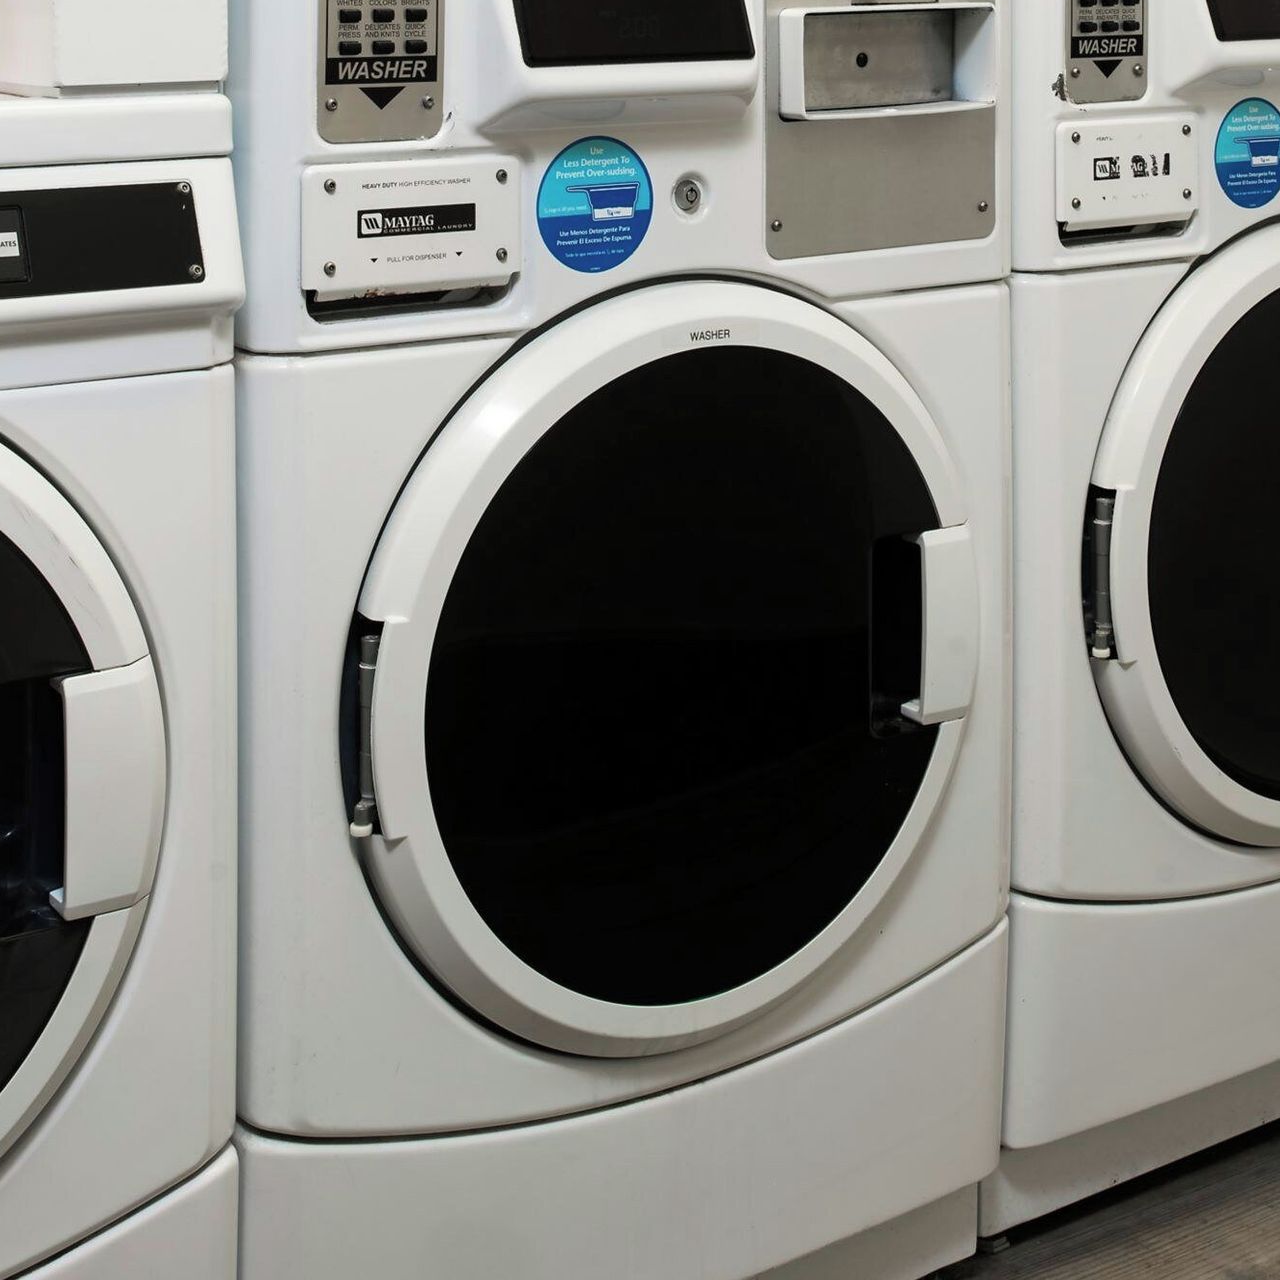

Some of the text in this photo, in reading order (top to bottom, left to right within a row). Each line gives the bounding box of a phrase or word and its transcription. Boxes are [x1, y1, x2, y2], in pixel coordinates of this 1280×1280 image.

[336, 0, 363, 7] WHITES
[364, 23, 401, 31] DELICATES
[405, 23, 426, 31] QUICK
[337, 31, 361, 39] PRESS
[1078, 38, 1138, 55] WASHER
[338, 60, 428, 80] WASHER
[590, 147, 604, 155] Use
[563, 155, 630, 168] Less Detergent To
[556, 166, 637, 180] Prevent Over-sudsing.
[413, 179, 446, 187] EFFICIENCY
[384, 214, 434, 229] MAYTAG
[383, 226, 435, 234] COMMERCIAL
[570, 228, 588, 236] Menos
[589, 227, 618, 236] Detergente
[414, 253, 447, 261] DISPENSER
[690, 329, 731, 342] WASHER
